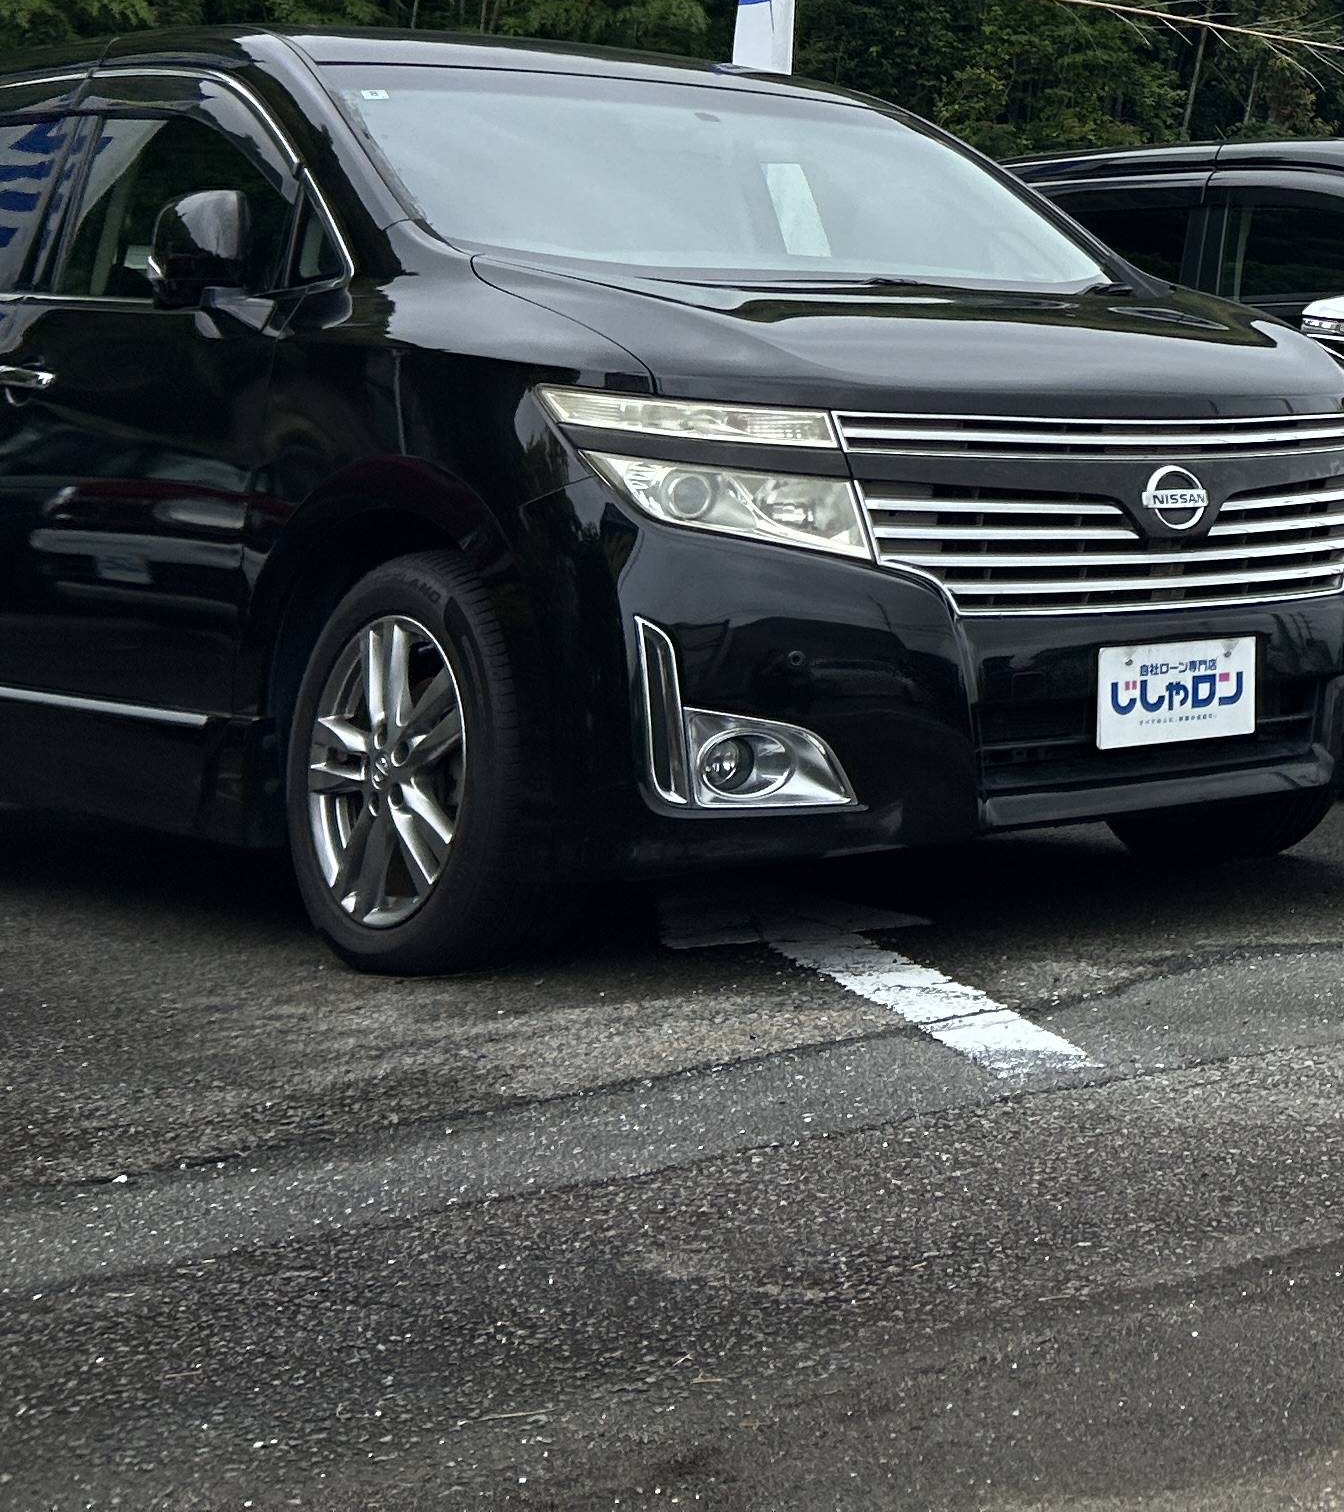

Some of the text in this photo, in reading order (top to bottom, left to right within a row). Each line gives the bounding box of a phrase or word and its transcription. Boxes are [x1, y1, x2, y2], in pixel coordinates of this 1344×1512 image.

[1152, 493, 1205, 505] NISSAN
[1139, 658, 1218, 677] 自社ローン専門店
